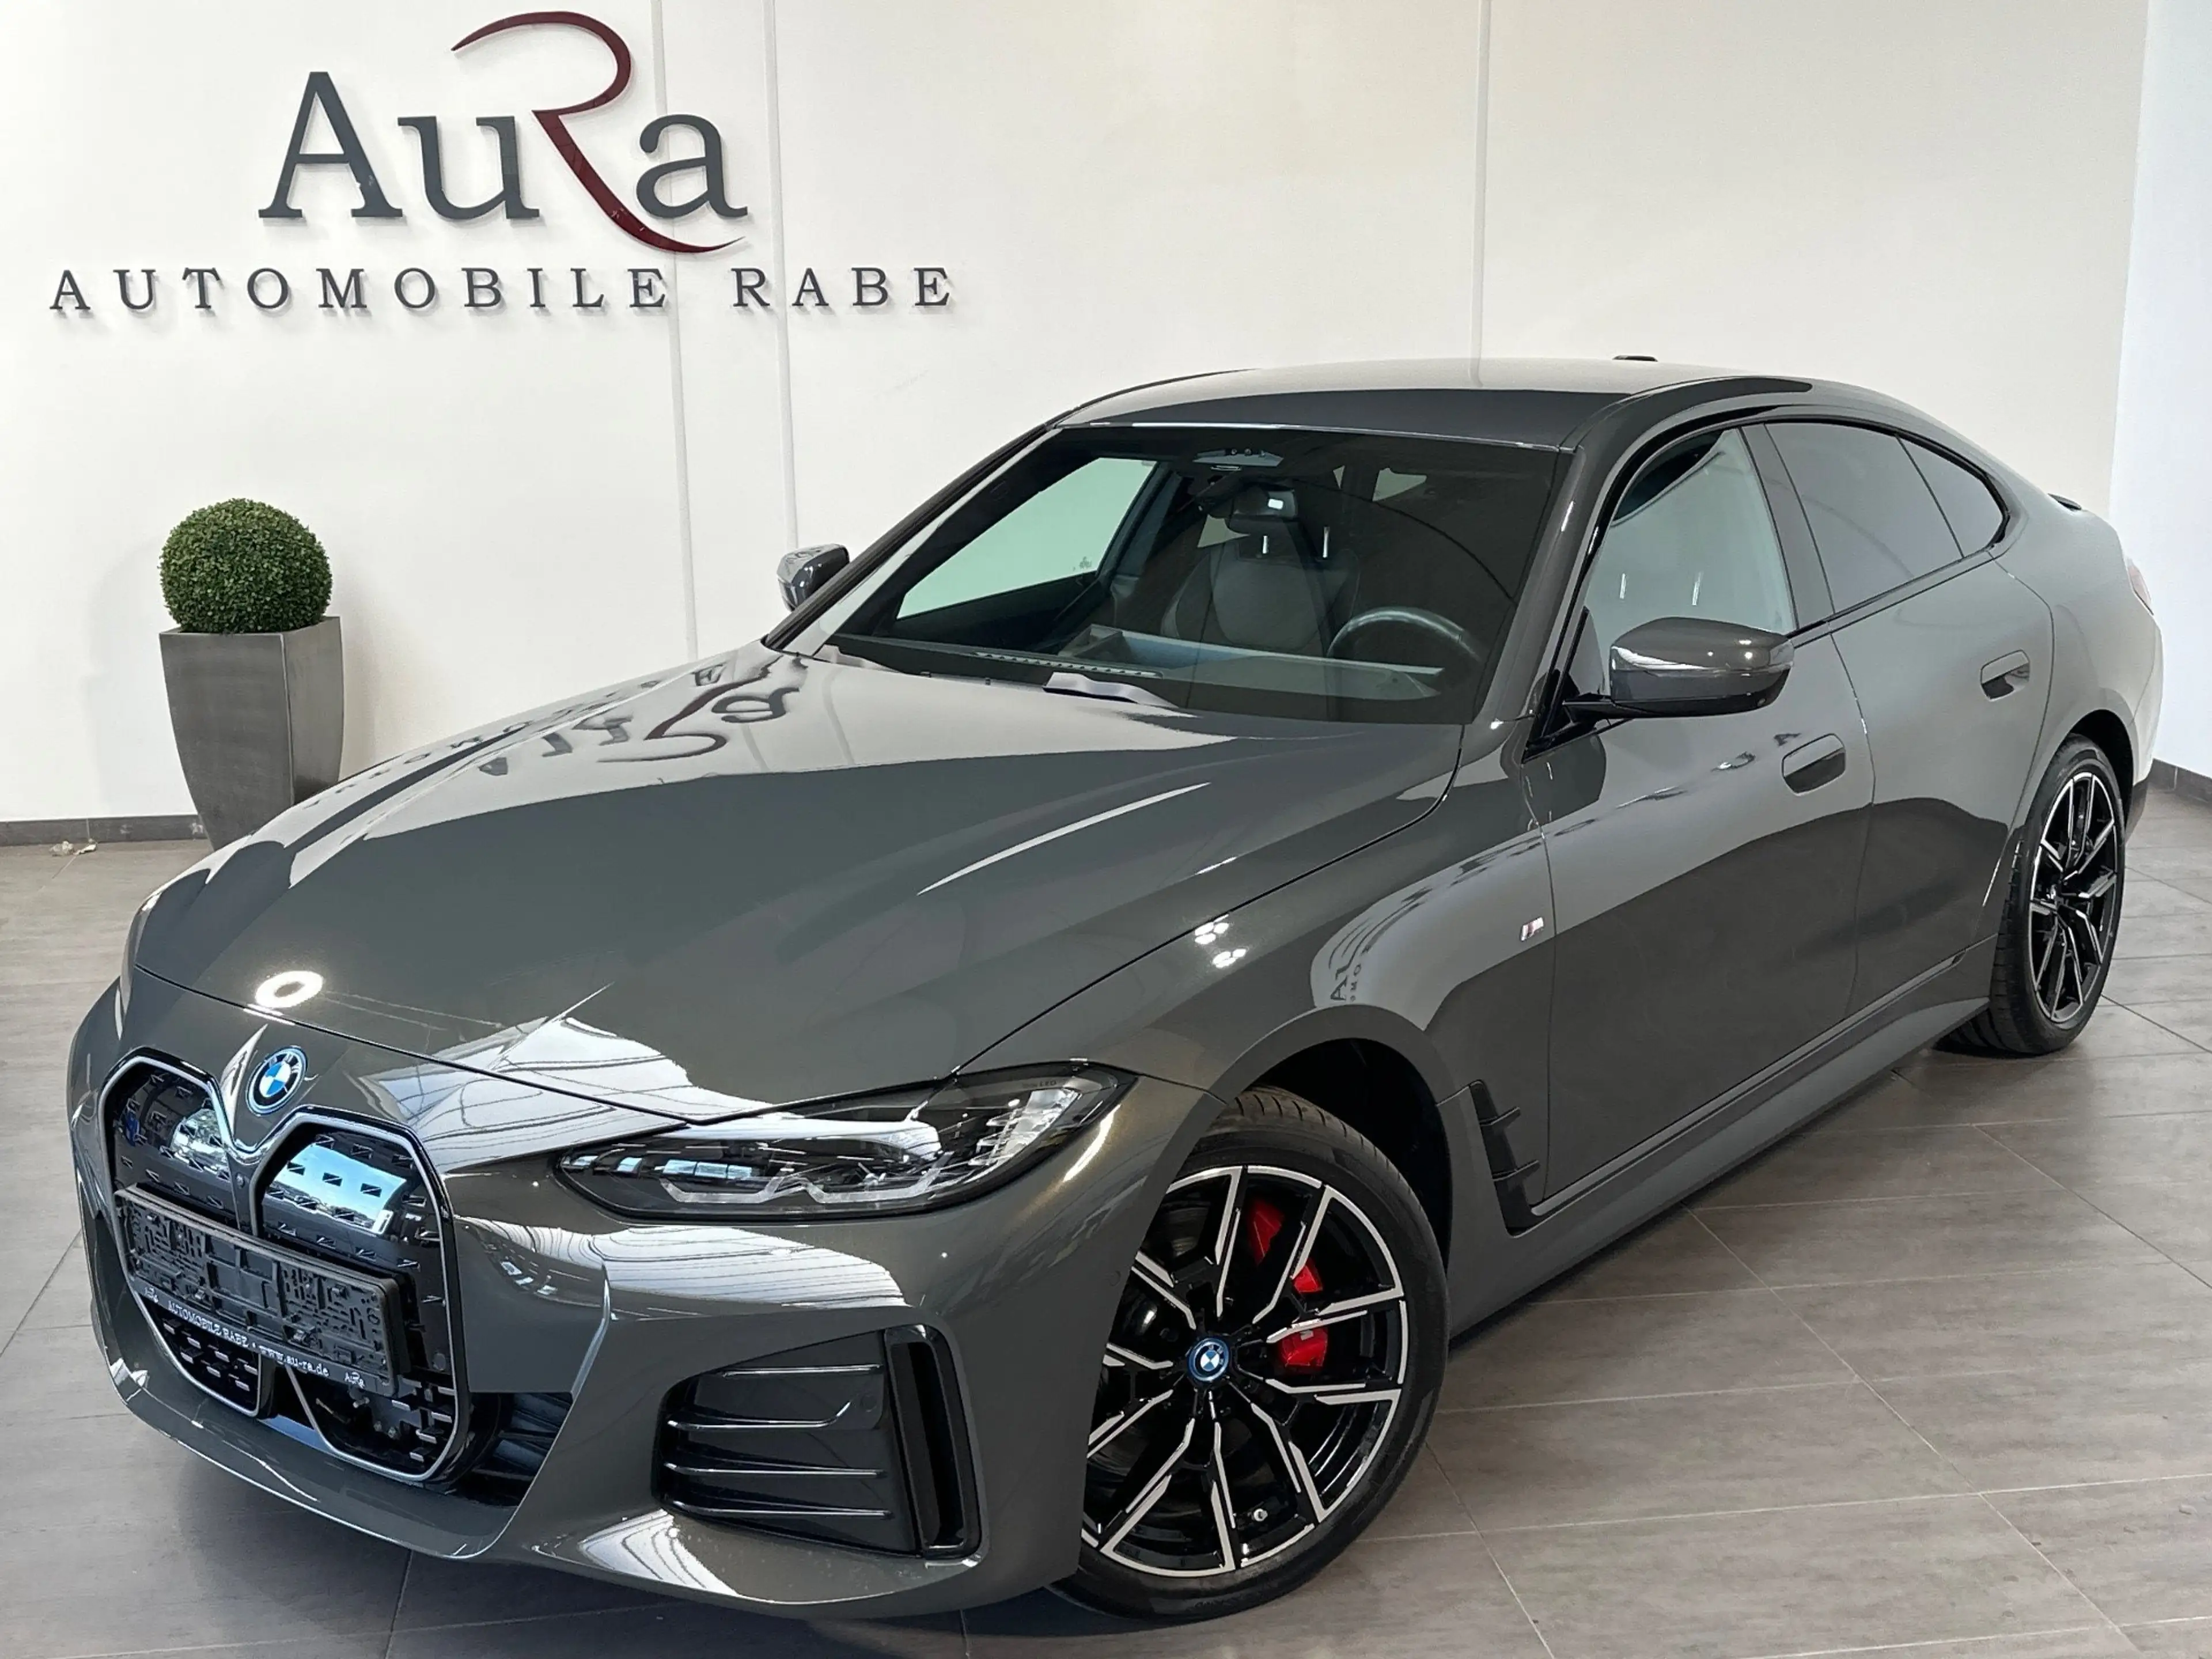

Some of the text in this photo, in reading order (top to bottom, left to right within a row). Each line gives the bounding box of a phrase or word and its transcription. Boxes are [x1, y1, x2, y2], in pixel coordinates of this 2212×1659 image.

[259, 11, 748, 255] AuRa
[50, 267, 949, 312] AUTOMOBILE RABE
